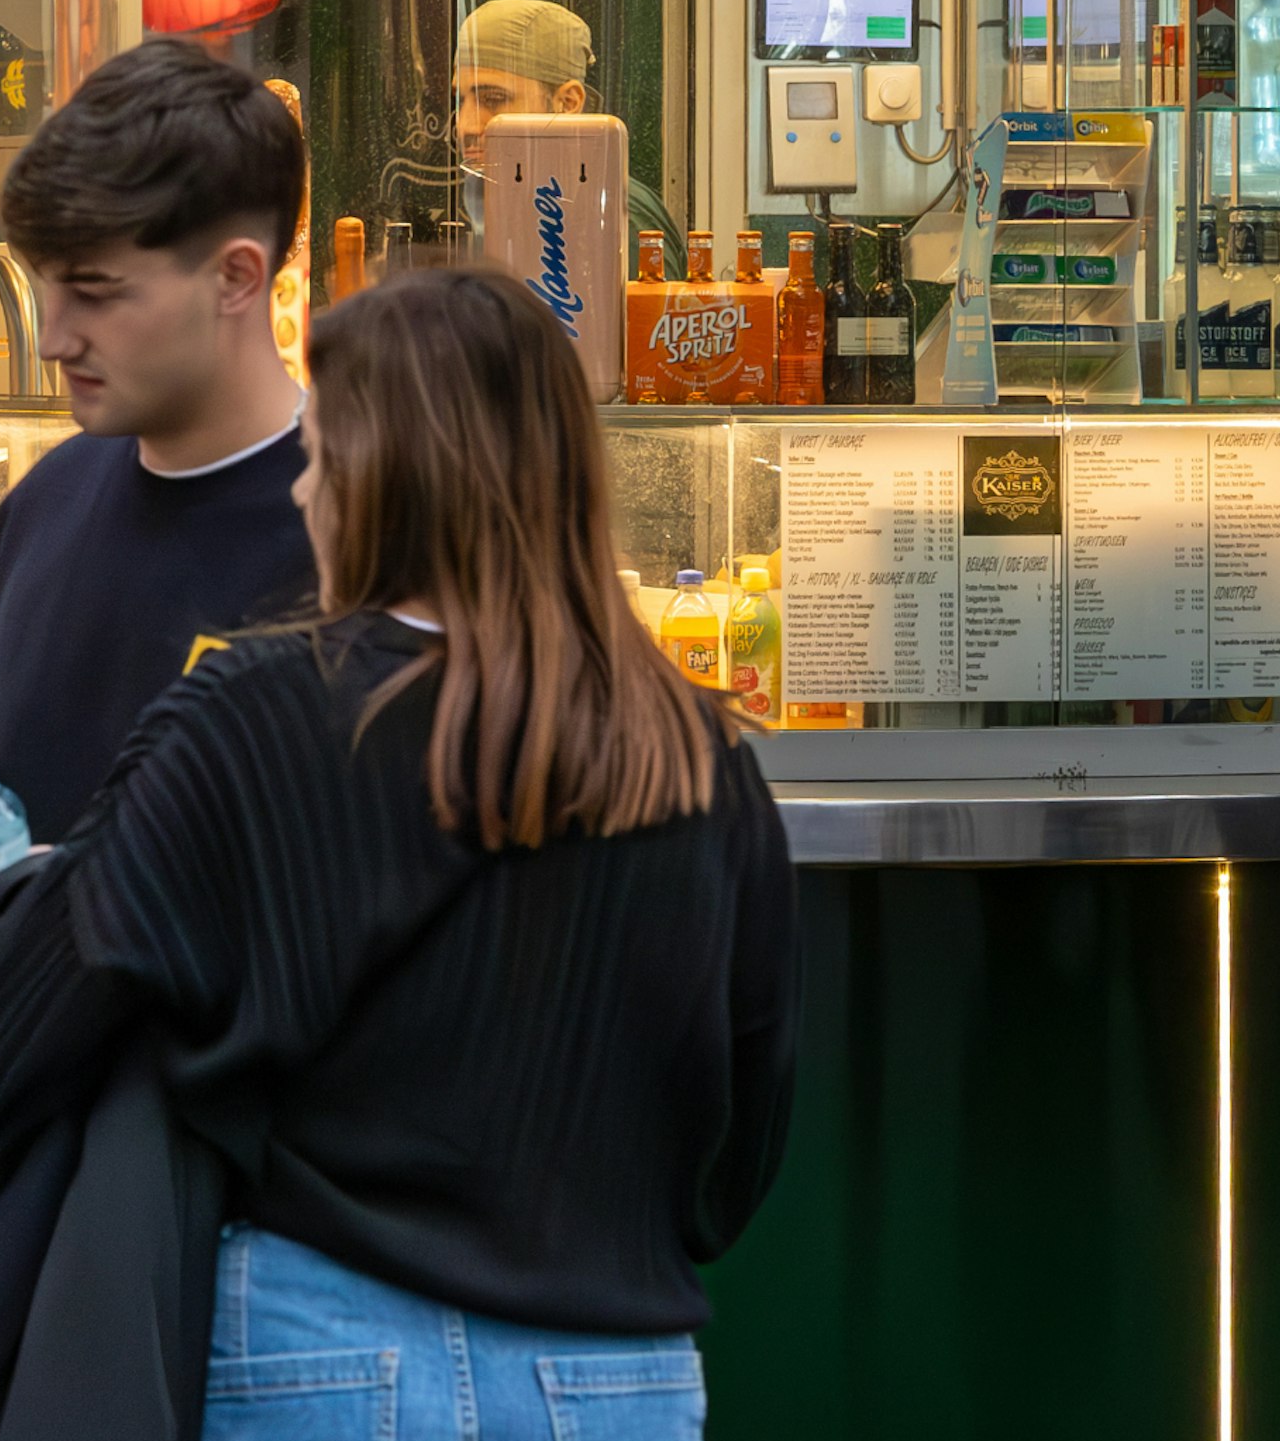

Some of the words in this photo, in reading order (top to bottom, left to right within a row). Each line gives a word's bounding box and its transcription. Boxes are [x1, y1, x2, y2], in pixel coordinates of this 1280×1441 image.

[1010, 121, 1039, 133] Orbit
[648, 304, 753, 350] APEROL
[1100, 434, 1123, 447] BEER
[982, 476, 1042, 497] KAISER
